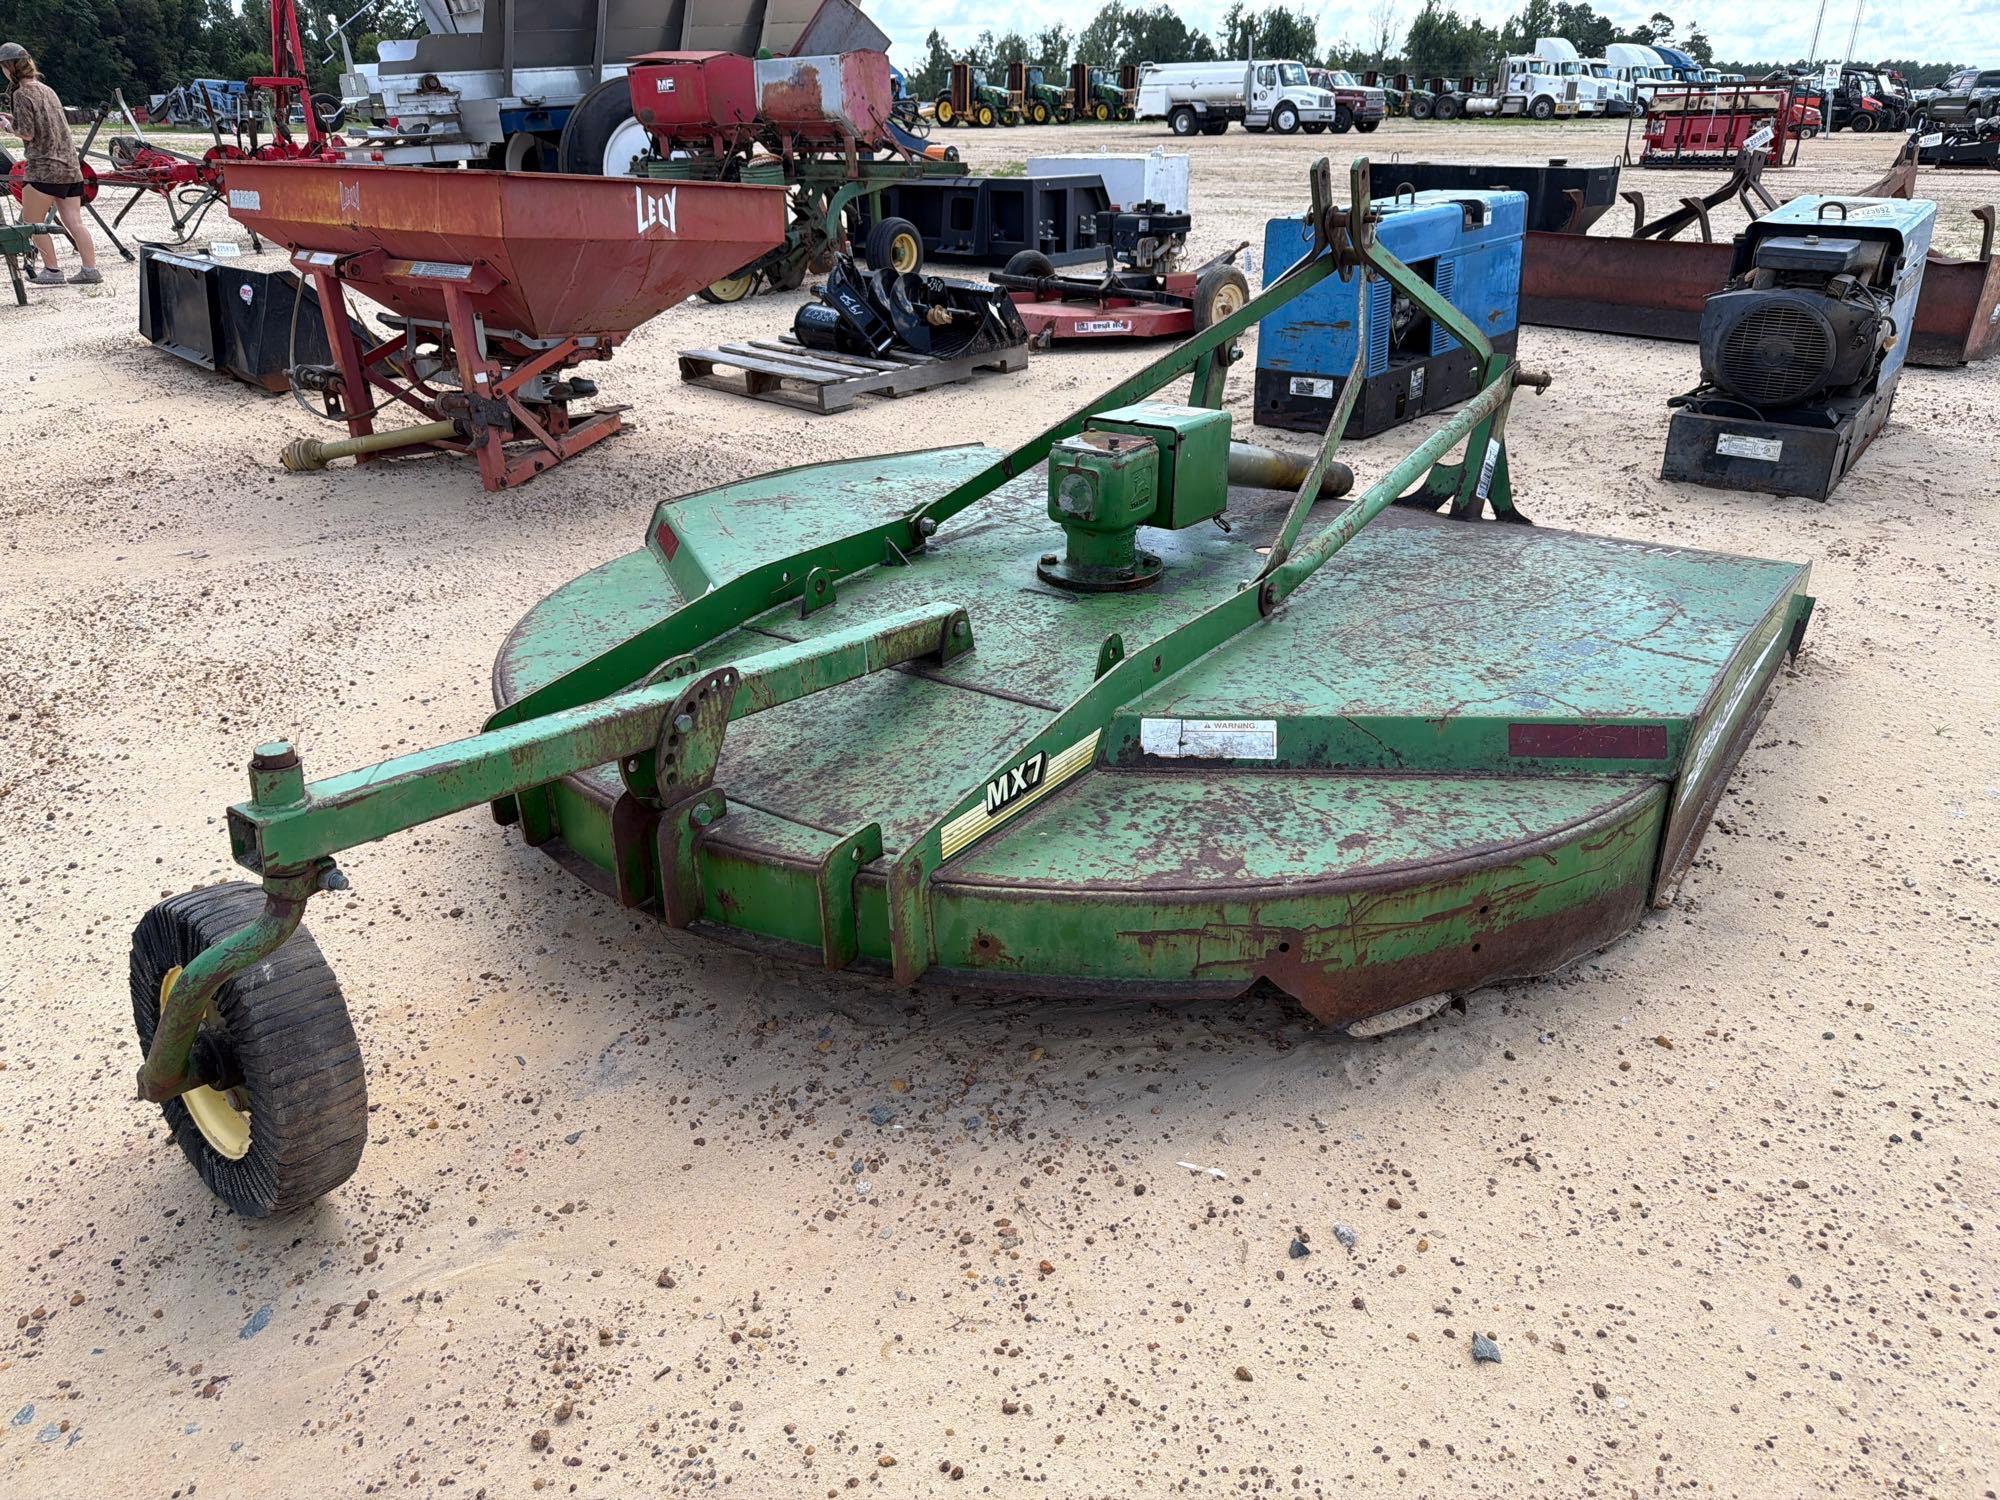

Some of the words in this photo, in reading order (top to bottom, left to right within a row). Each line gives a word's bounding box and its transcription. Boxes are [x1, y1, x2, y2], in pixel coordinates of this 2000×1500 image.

[657, 79, 673, 90] MF
[635, 185, 677, 234] LELY
[986, 750, 1047, 817] MX7
